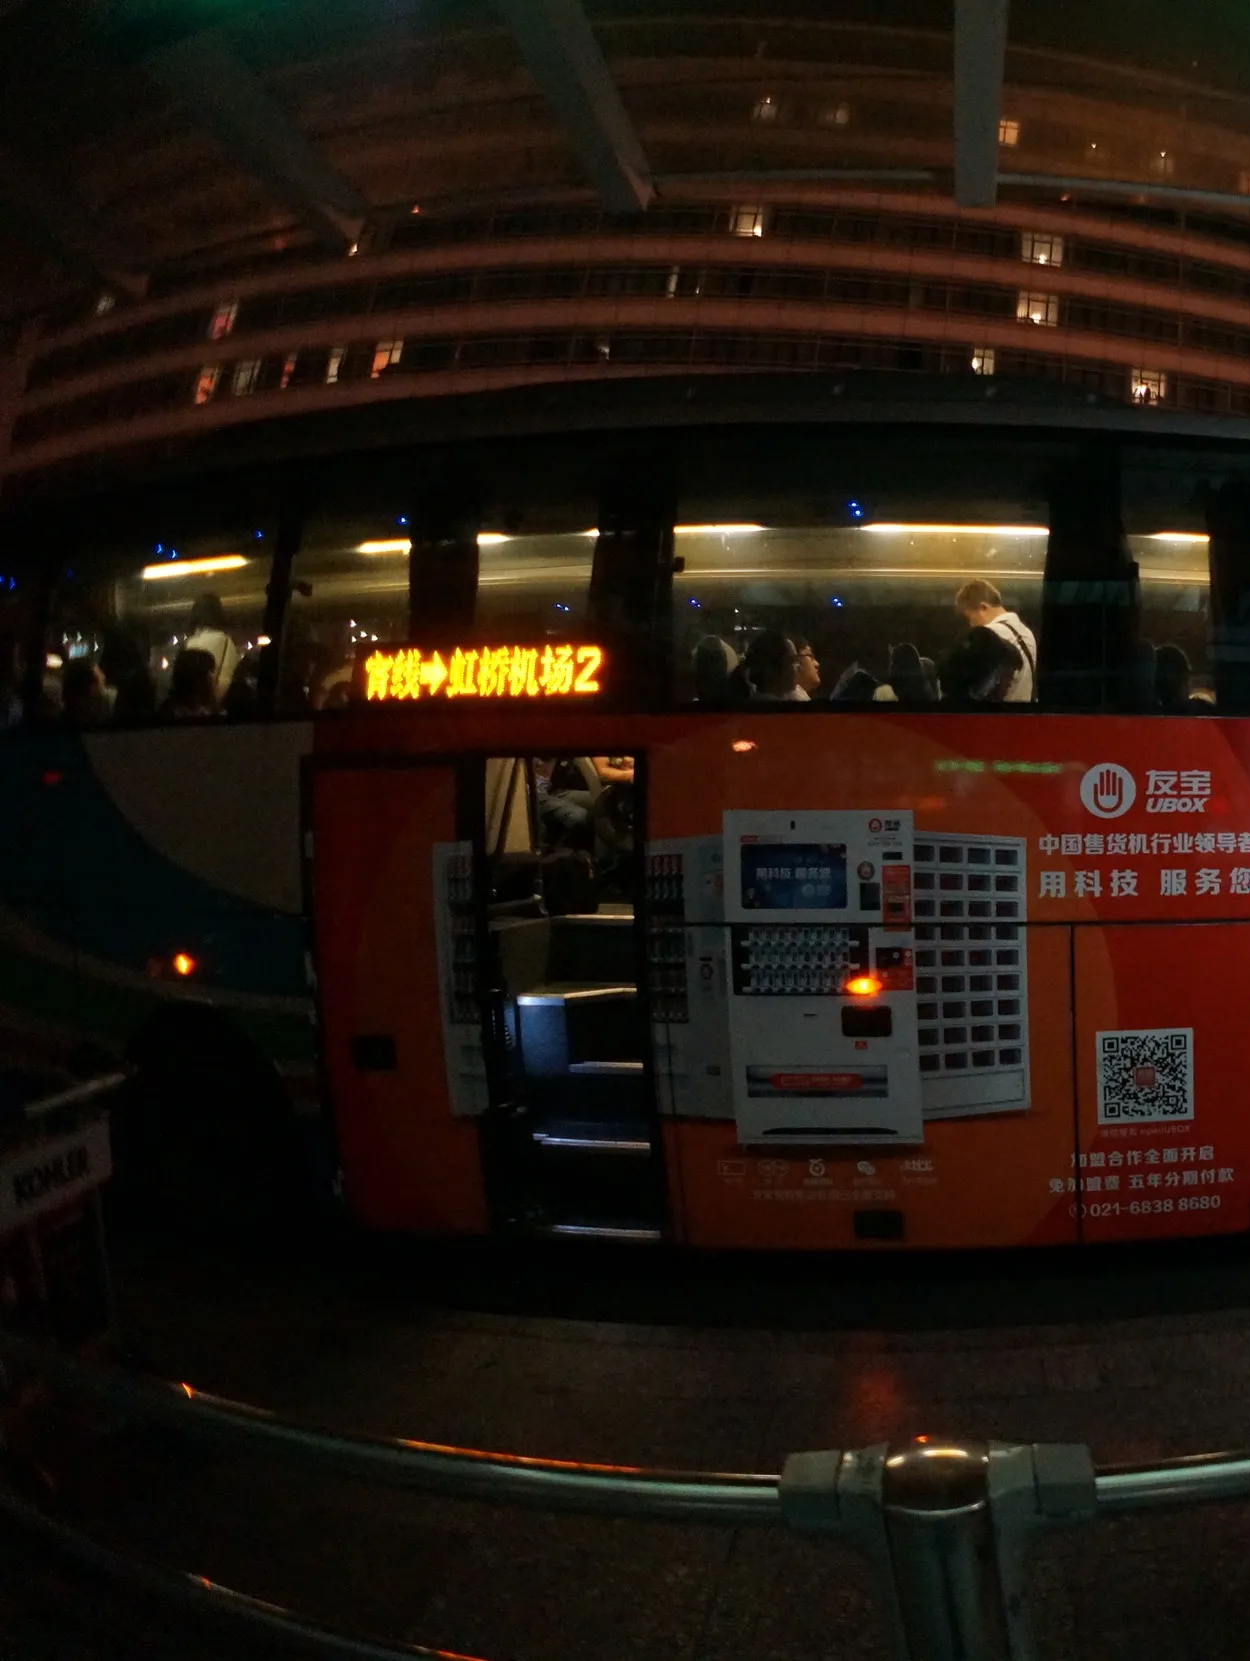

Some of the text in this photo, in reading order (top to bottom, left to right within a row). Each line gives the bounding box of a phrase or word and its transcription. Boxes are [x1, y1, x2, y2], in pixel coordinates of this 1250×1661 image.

[1145, 770, 1211, 795] 友宝
[1146, 798, 1208, 813] UBOX
[1039, 869, 1139, 898] 用科技
[1070, 1145, 1215, 1168] 加盟合作全面开启
[1128, 1168, 1235, 1190] 五年分期付款
[1089, 1195, 1222, 1217] 021-6838 8680
